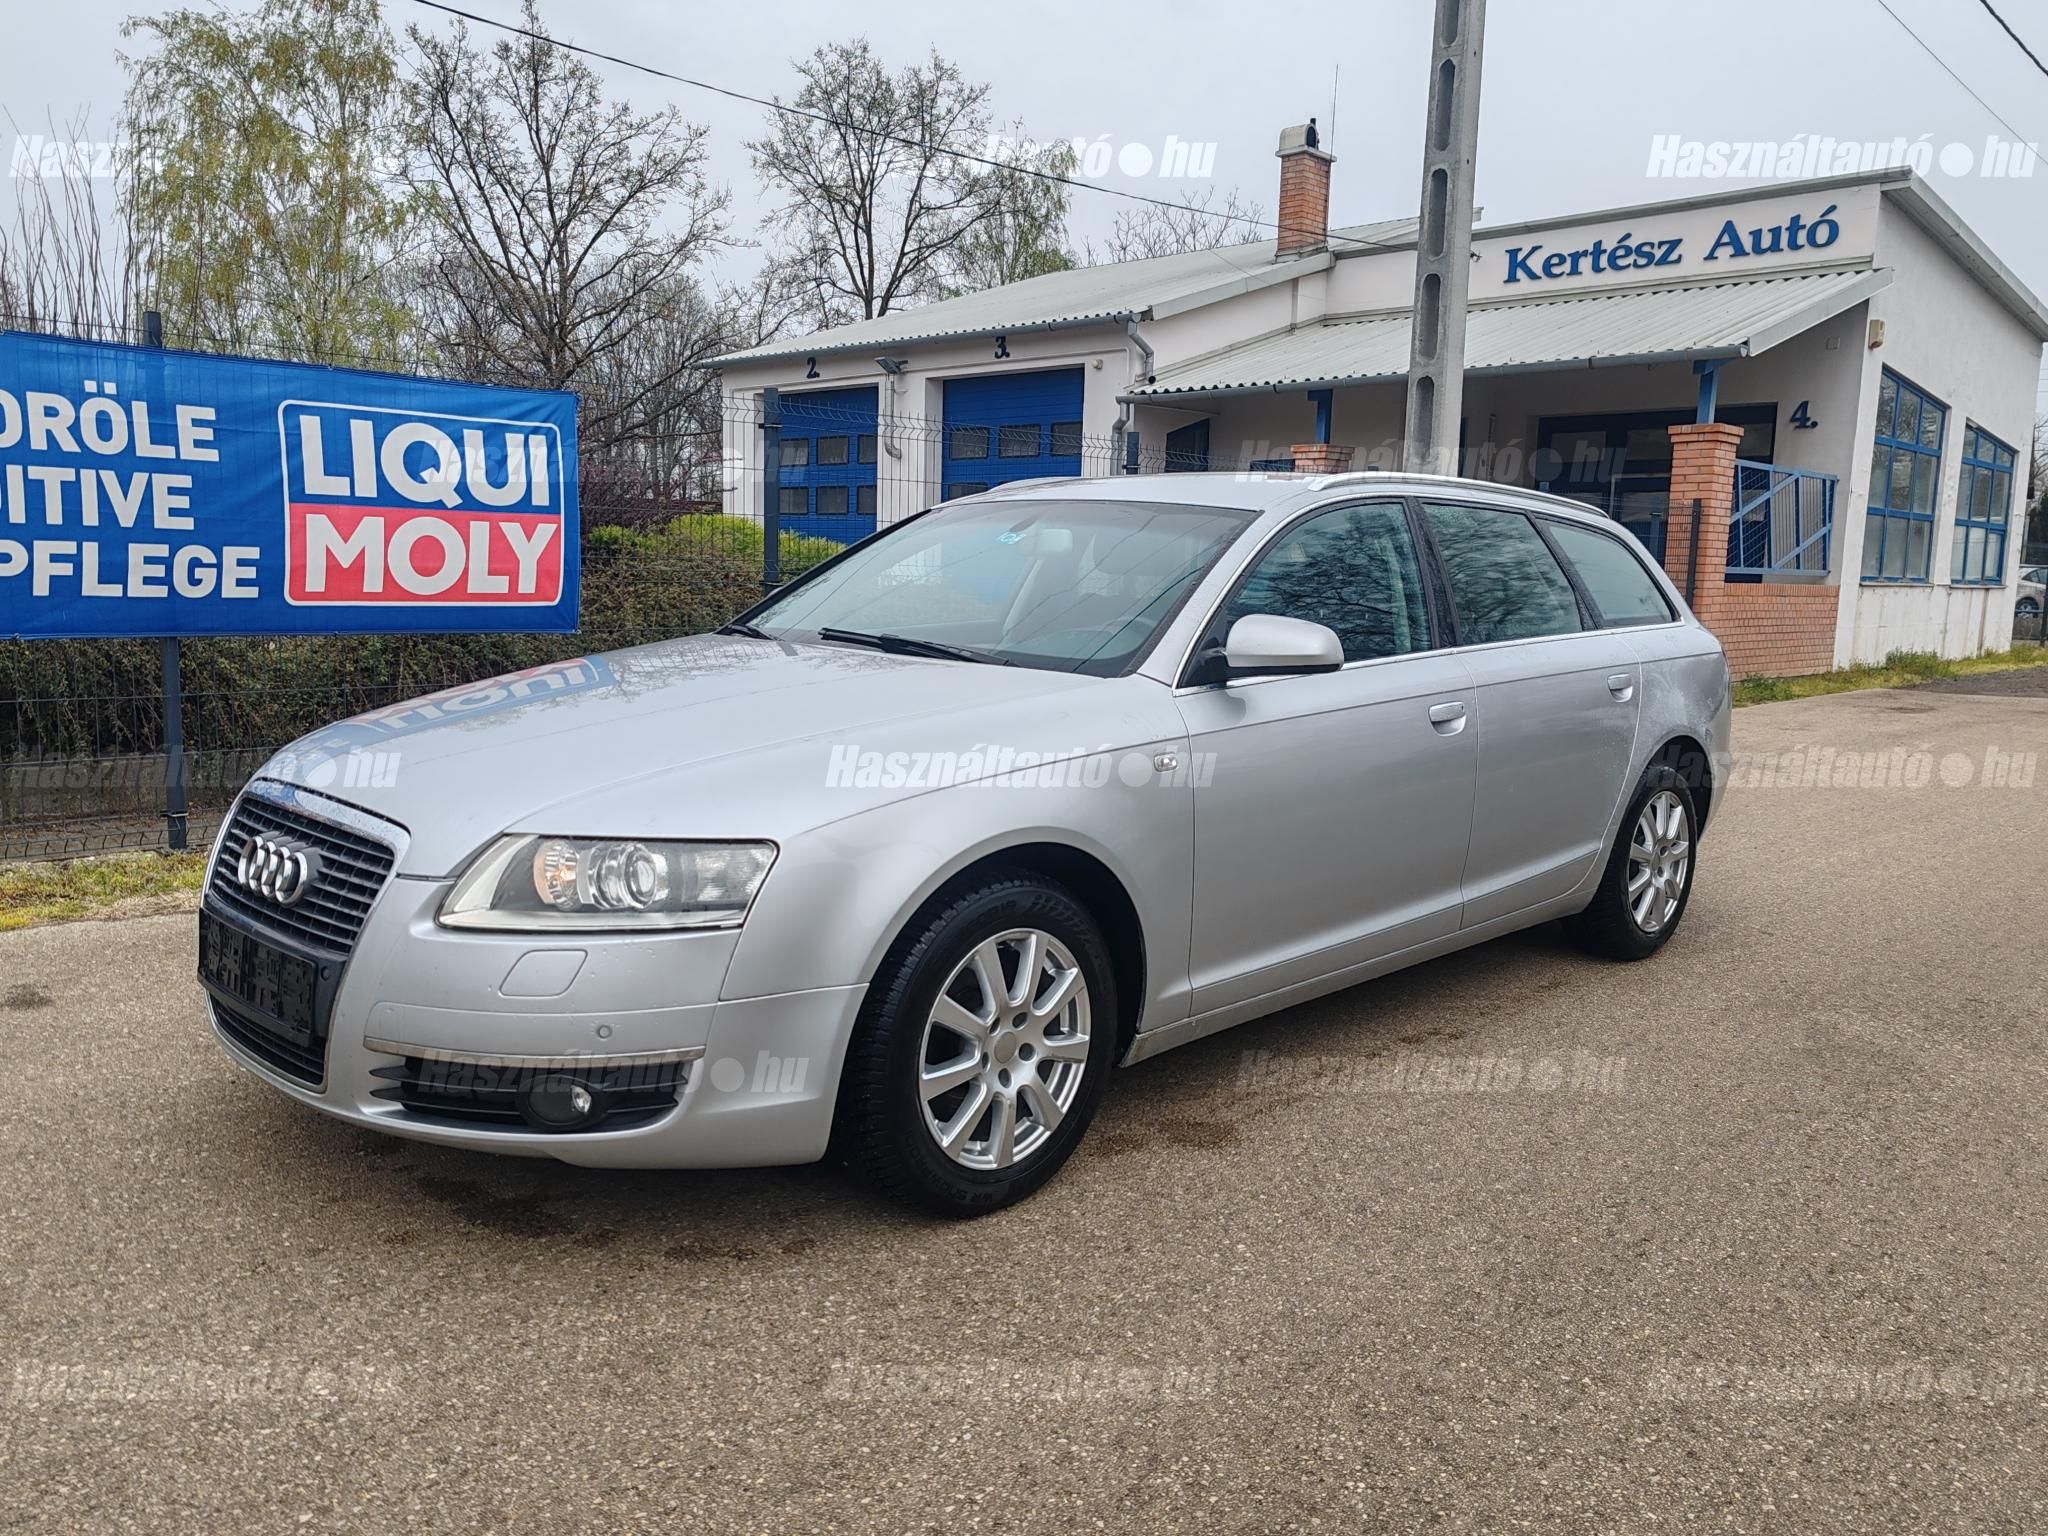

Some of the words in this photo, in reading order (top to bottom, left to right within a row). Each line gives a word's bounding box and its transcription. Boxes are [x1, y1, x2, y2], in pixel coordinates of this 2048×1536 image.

[1503, 232, 1683, 283] Kertész
[1703, 204, 1840, 260] Autó
[1789, 400, 1818, 430] 4.
[299, 415, 551, 509] LIQUI
[305, 513, 557, 595] MOLY
